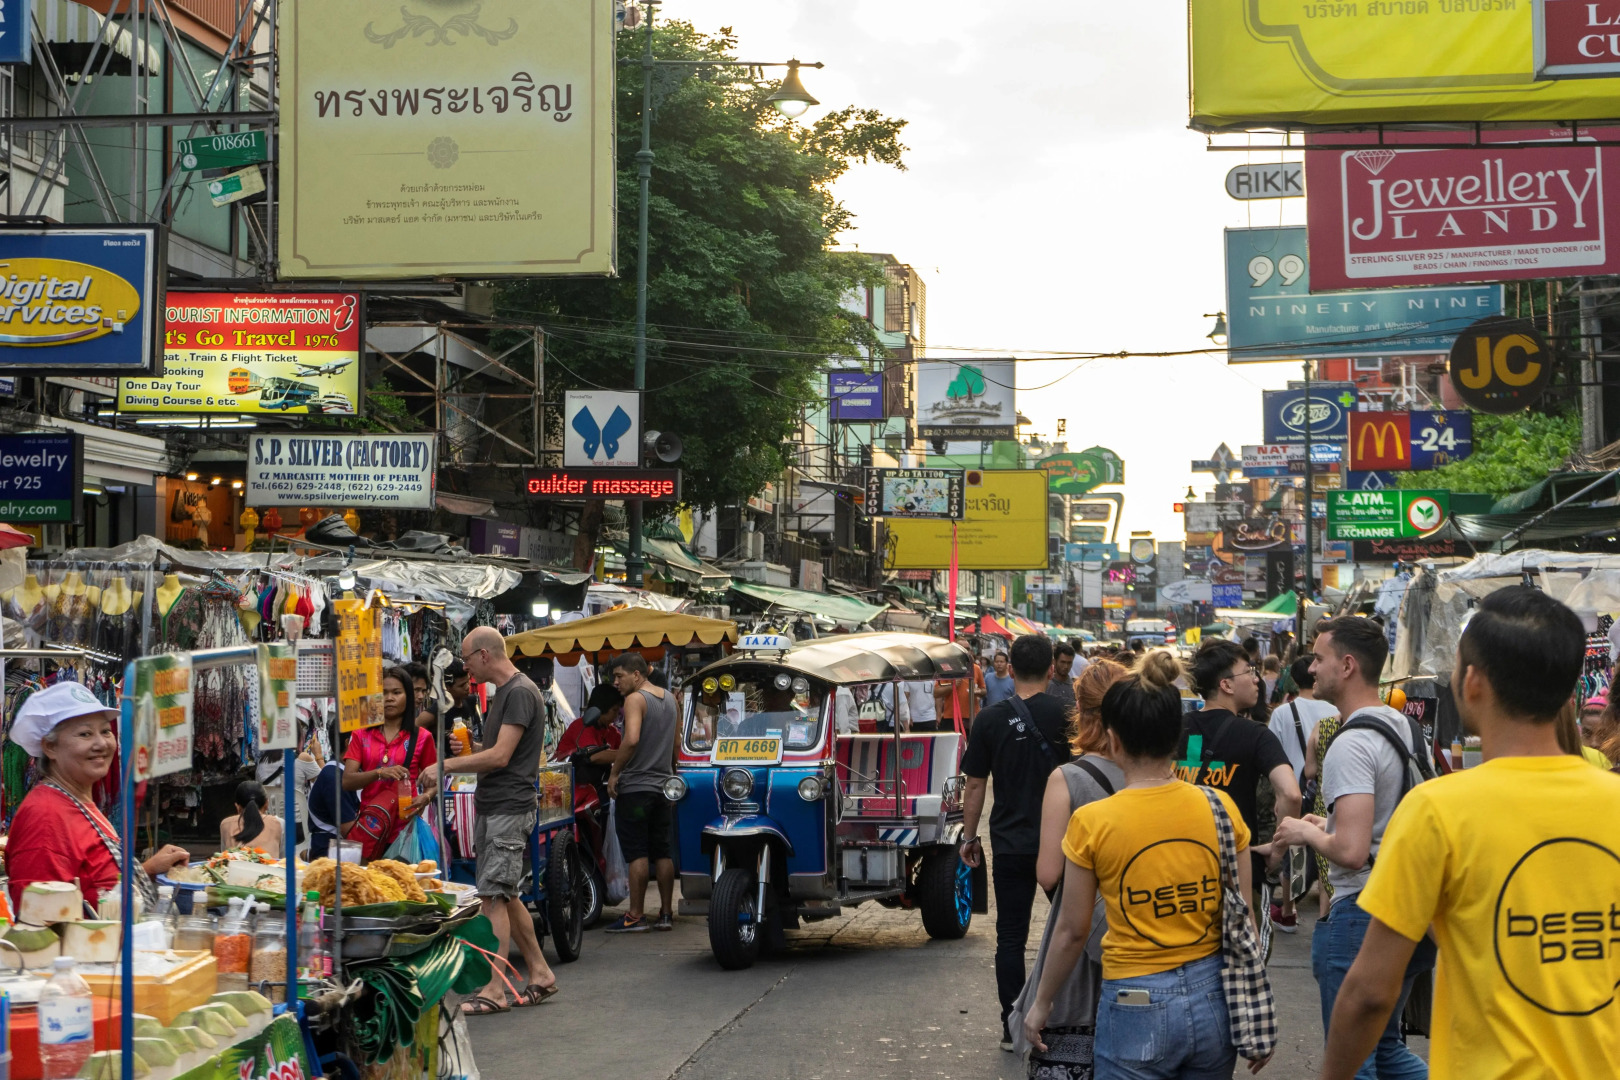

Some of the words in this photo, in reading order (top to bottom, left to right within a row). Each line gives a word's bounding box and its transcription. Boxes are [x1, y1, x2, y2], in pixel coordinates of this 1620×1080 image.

[314, 71, 572, 123] ทรงพระเจริญ
[212, 133, 256, 151] 018661
[1236, 170, 1302, 194] RIKK
[1391, 208, 1558, 239] LAND
[1351, 256, 1393, 265] STERLING
[1396, 253, 1426, 262] SILVER
[1427, 252, 1444, 260] 925
[1451, 249, 1512, 259] MANUFACTURER
[1517, 247, 1541, 255] MADE
[1541, 246, 1551, 254] TO
[1552, 245, 1577, 253] ORDER
[1248, 254, 1305, 288] 99
[1413, 263, 1438, 271] BEADS
[1443, 261, 1467, 269] CHAIN
[1473, 259, 1508, 267] FINDINGS
[165, 307, 221, 323] OURIST
[225, 307, 330, 323] INFORMATION
[1250, 301, 1377, 316] NINETY
[1408, 296, 1490, 309] NINE
[196, 330, 224, 346] Go
[233, 329, 297, 347] Travel
[304, 333, 339, 347] 1976
[1306, 325, 1360, 334] Manufacturer
[190, 353, 217, 362] Train
[231, 354, 262, 364] Flight
[266, 354, 298, 362] Ticket
[1459, 333, 1542, 389] JC
[126, 381, 147, 390] One
[151, 382, 172, 392] Day
[175, 382, 201, 391] Tour
[126, 395, 159, 407] Diving
[162, 396, 202, 406] Course
[217, 398, 239, 406] etc.
[1421, 427, 1456, 451] 24
[255, 439, 283, 465] S.P.
[289, 439, 342, 466] SILVER
[346, 440, 429, 472] (FACTORY)
[1257, 446, 1289, 454] NAT
[0, 449, 68, 472] ewelry
[14, 477, 42, 489] 925
[259, 472, 270, 480] CZ
[273, 473, 326, 481] MARCASITE
[296, 482, 345, 492] 629-2448,
[348, 483, 373, 492] (622)
[377, 484, 422, 492] 629-2449
[528, 474, 587, 494] oulder
[592, 480, 674, 498] massage
[868, 469, 880, 514] TATTOO
[278, 492, 399, 502] www.spsilverjewelry.com
[951, 477, 961, 518] TATTOO
[1352, 493, 1384, 505] ATM
[1337, 528, 1395, 538] EXCHANGE
[745, 636, 778, 646] TAXI
[719, 741, 738, 753] สก
[744, 741, 777, 753] 4669
[1127, 875, 1217, 905] best
[1153, 896, 1216, 919] bar
[1507, 902, 1620, 938] best
